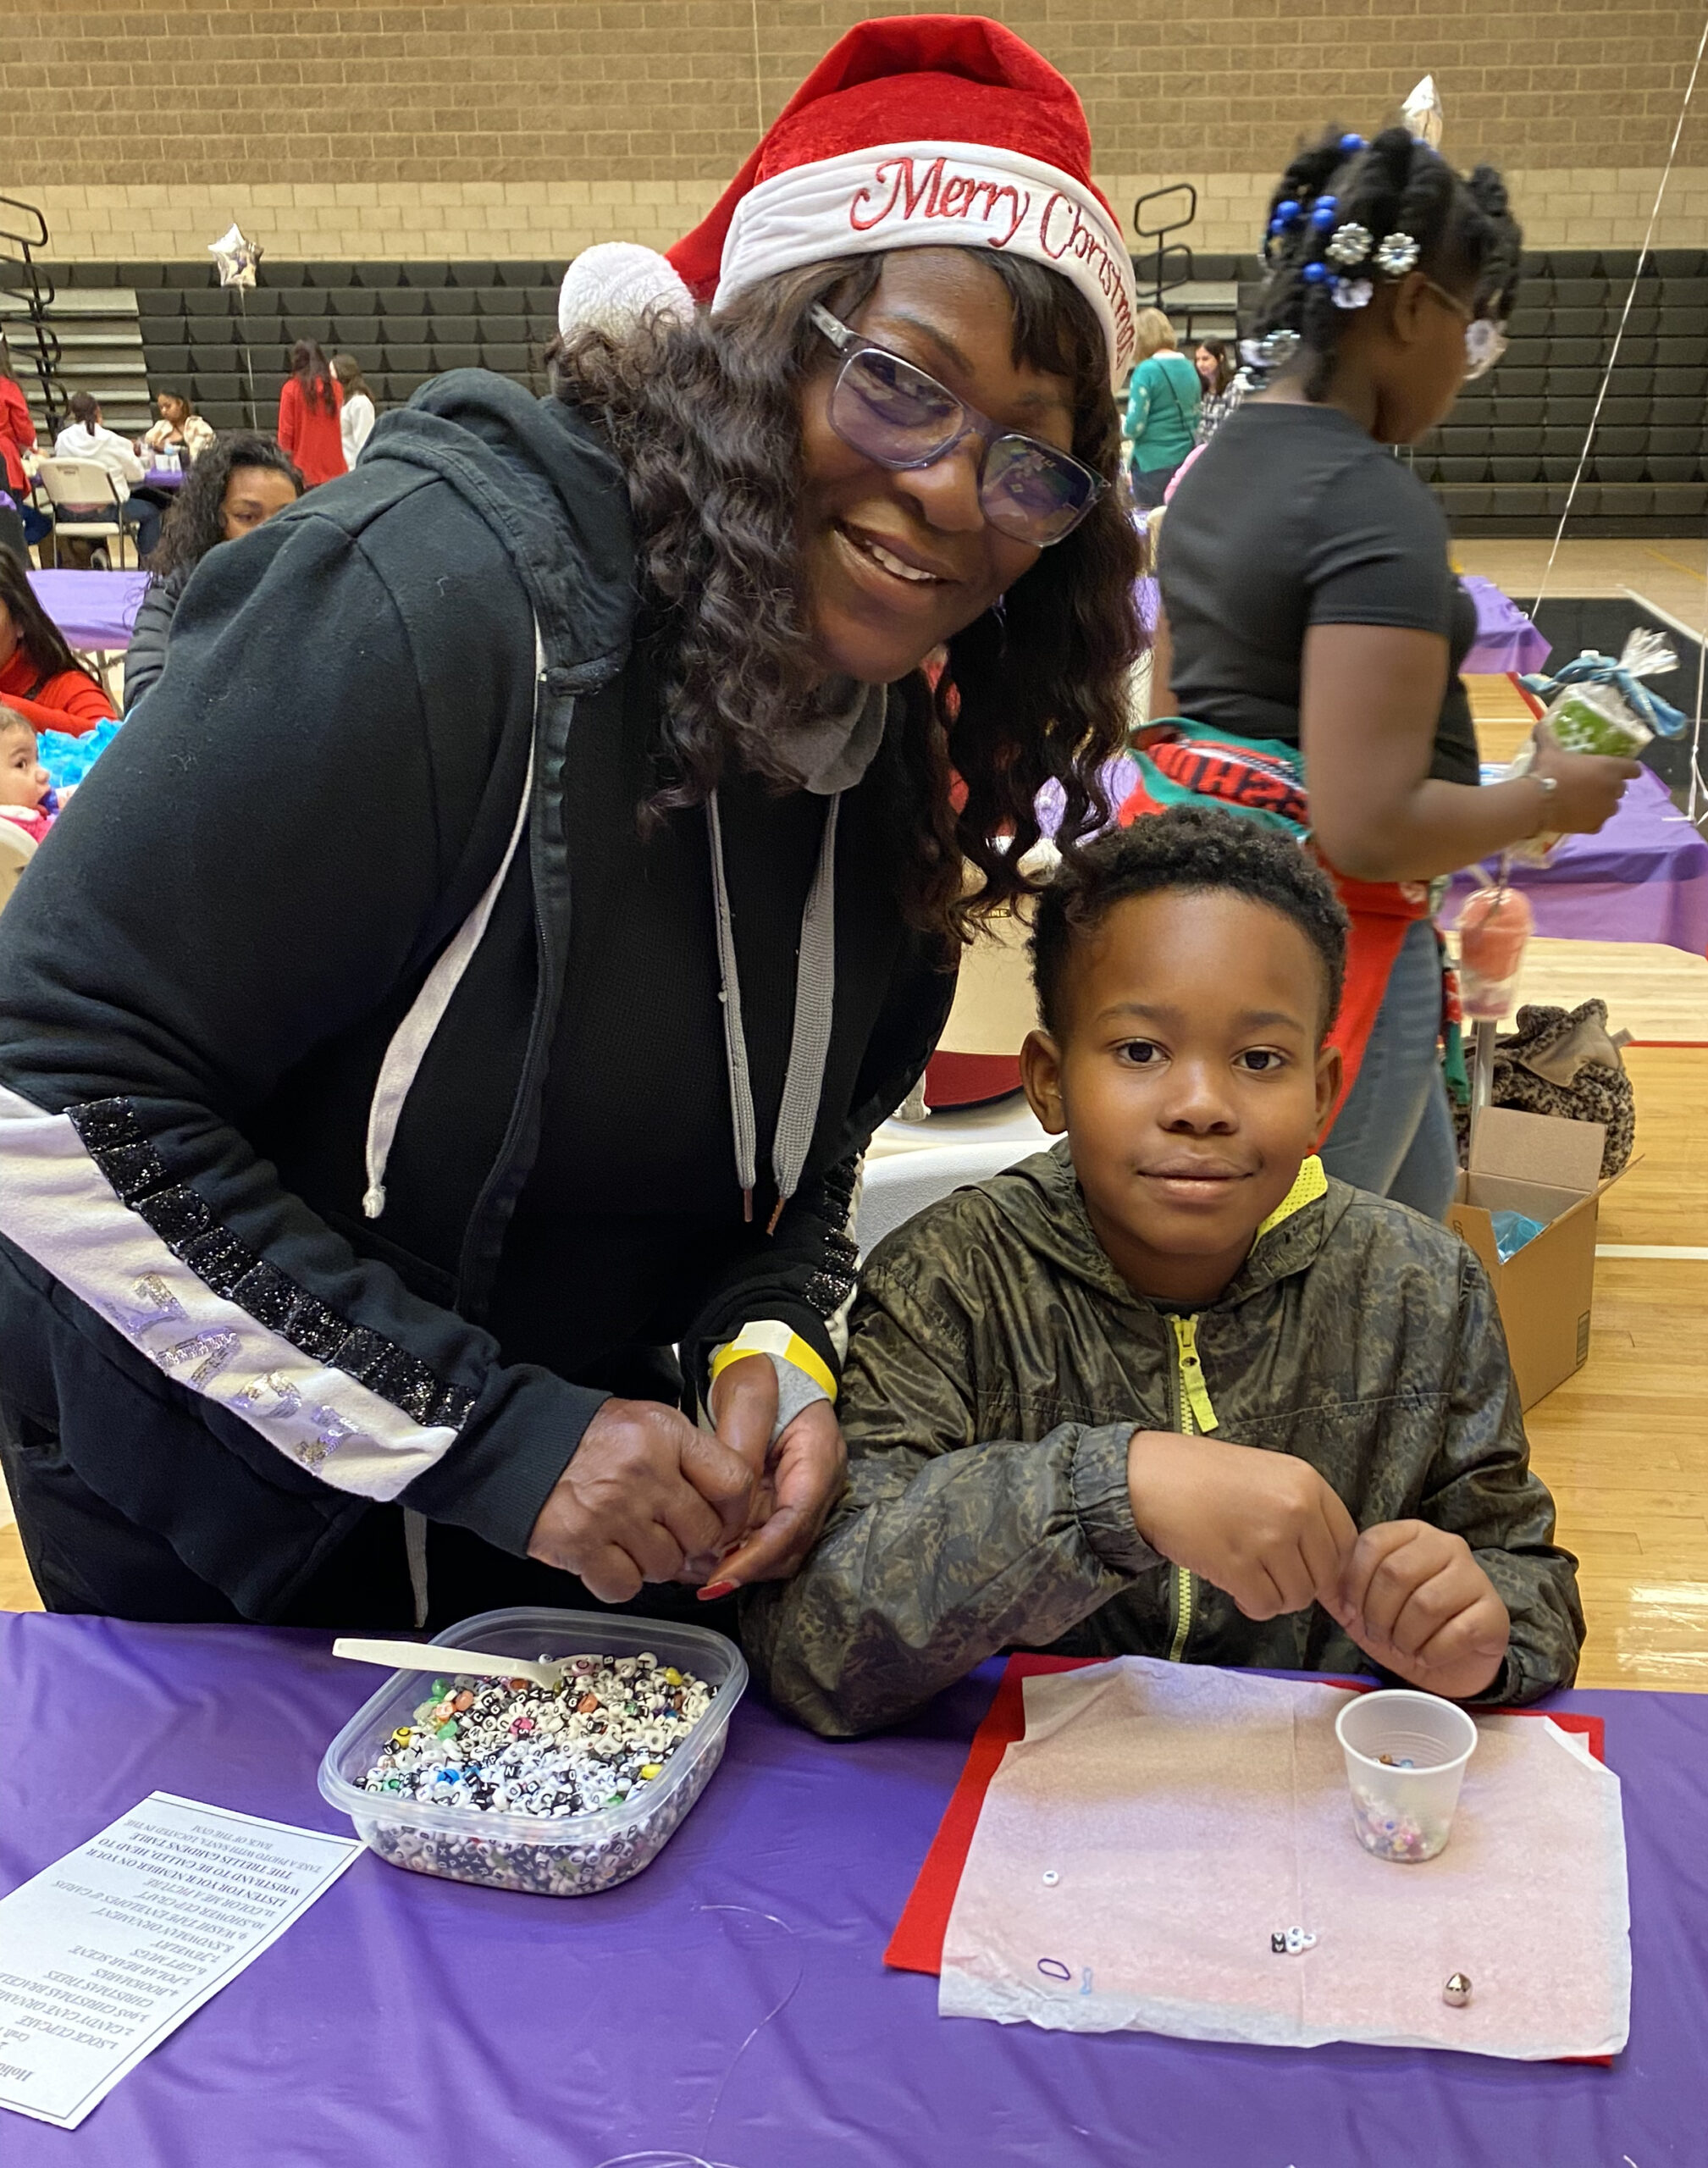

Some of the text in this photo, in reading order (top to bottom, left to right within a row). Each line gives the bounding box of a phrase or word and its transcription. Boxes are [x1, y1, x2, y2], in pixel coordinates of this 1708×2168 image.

[849, 157, 1031, 248] Merry
[123, 1818, 146, 1830] THE
[142, 1823, 157, 1832] IN
[97, 1838, 117, 1849] TO
[154, 1827, 199, 1844] LOCATED
[190, 1824, 274, 1850] BACK OF THE GYM
[114, 1843, 151, 1856] HEAD
[129, 1833, 293, 1880] THE TRELLIS GARDENS TABLE
[228, 1845, 256, 1858] WITH
[150, 1850, 197, 1869] CALLED,
[195, 1862, 214, 1873] BE
[254, 1852, 290, 1867] PHOTO
[289, 1859, 299, 1867] A
[295, 1861, 323, 1874] TAKE
[85, 1848, 287, 1907] LISTEN FOR YOUR NUMBER ON YOUR
[212, 1867, 231, 1878] TO
[51, 1879, 93, 1896] CARDS
[87, 1891, 105, 1900] &
[142, 1878, 196, 1897] PICTURE
[191, 1889, 207, 1899] A
[132, 1890, 177, 1906] CRAFT
[200, 1893, 225, 1905] ME
[100, 1894, 170, 1919] ENVELOPES
[173, 1900, 202, 1913] CUP
[90, 1907, 163, 1932] ORNAMENT
[164, 1913, 199, 1928] TAPE
[67, 1944, 113, 1962] SCENE
[129, 1948, 170, 1966] MUGS
[108, 1956, 145, 1972] BEAR
[42, 1970, 154, 2008] CHRISTMAS TREES
[44, 1988, 117, 2014] CHRISTMAS
[41, 2005, 81, 2021] CANE
[14, 2015, 75, 2038] CUPCAKE
